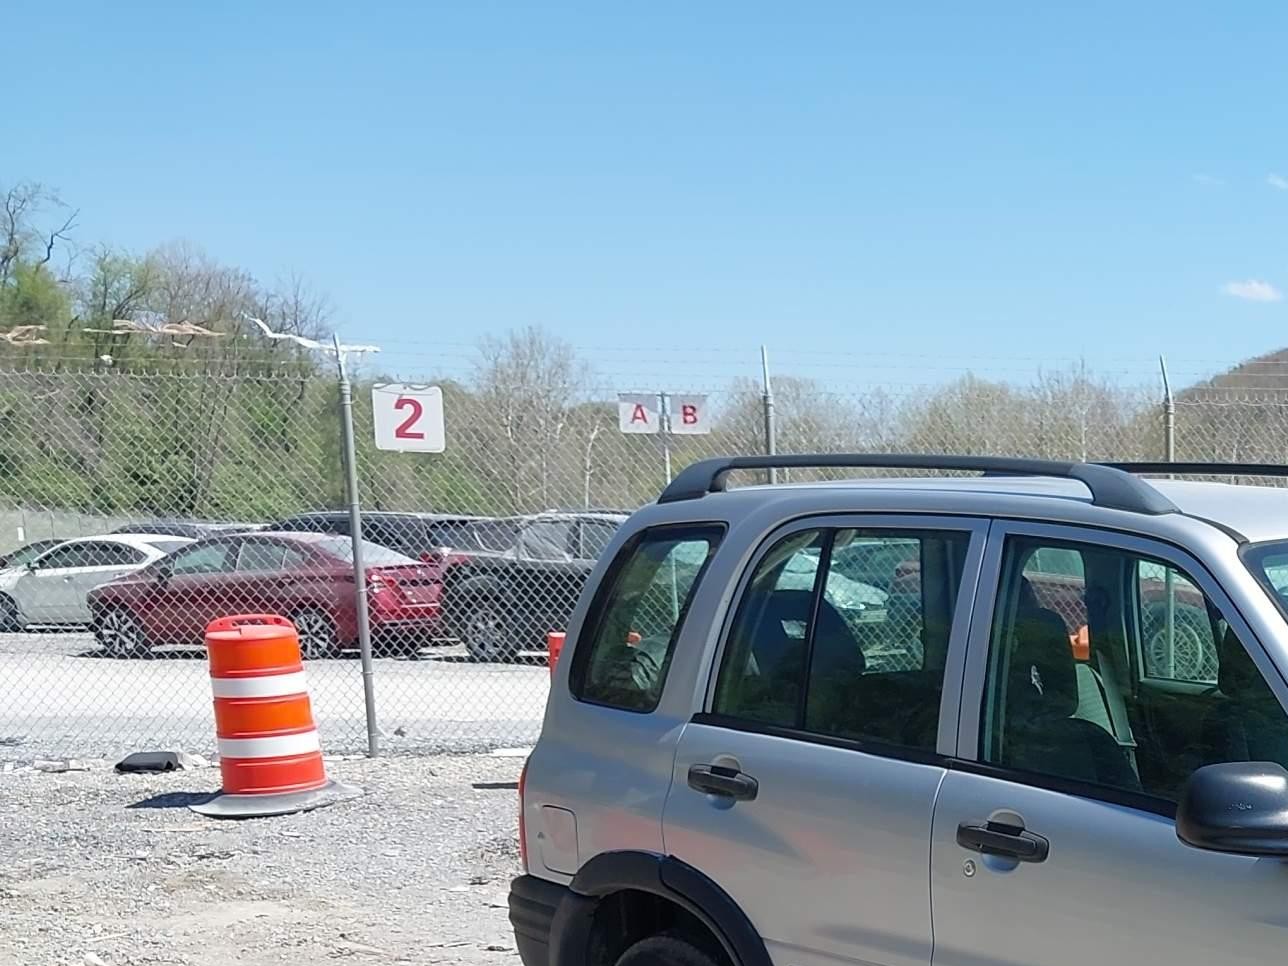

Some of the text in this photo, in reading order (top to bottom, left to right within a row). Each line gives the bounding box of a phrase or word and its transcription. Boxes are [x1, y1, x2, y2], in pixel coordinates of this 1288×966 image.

[394, 398, 424, 440] 2
[629, 403, 648, 425] A
[682, 404, 698, 425] B
